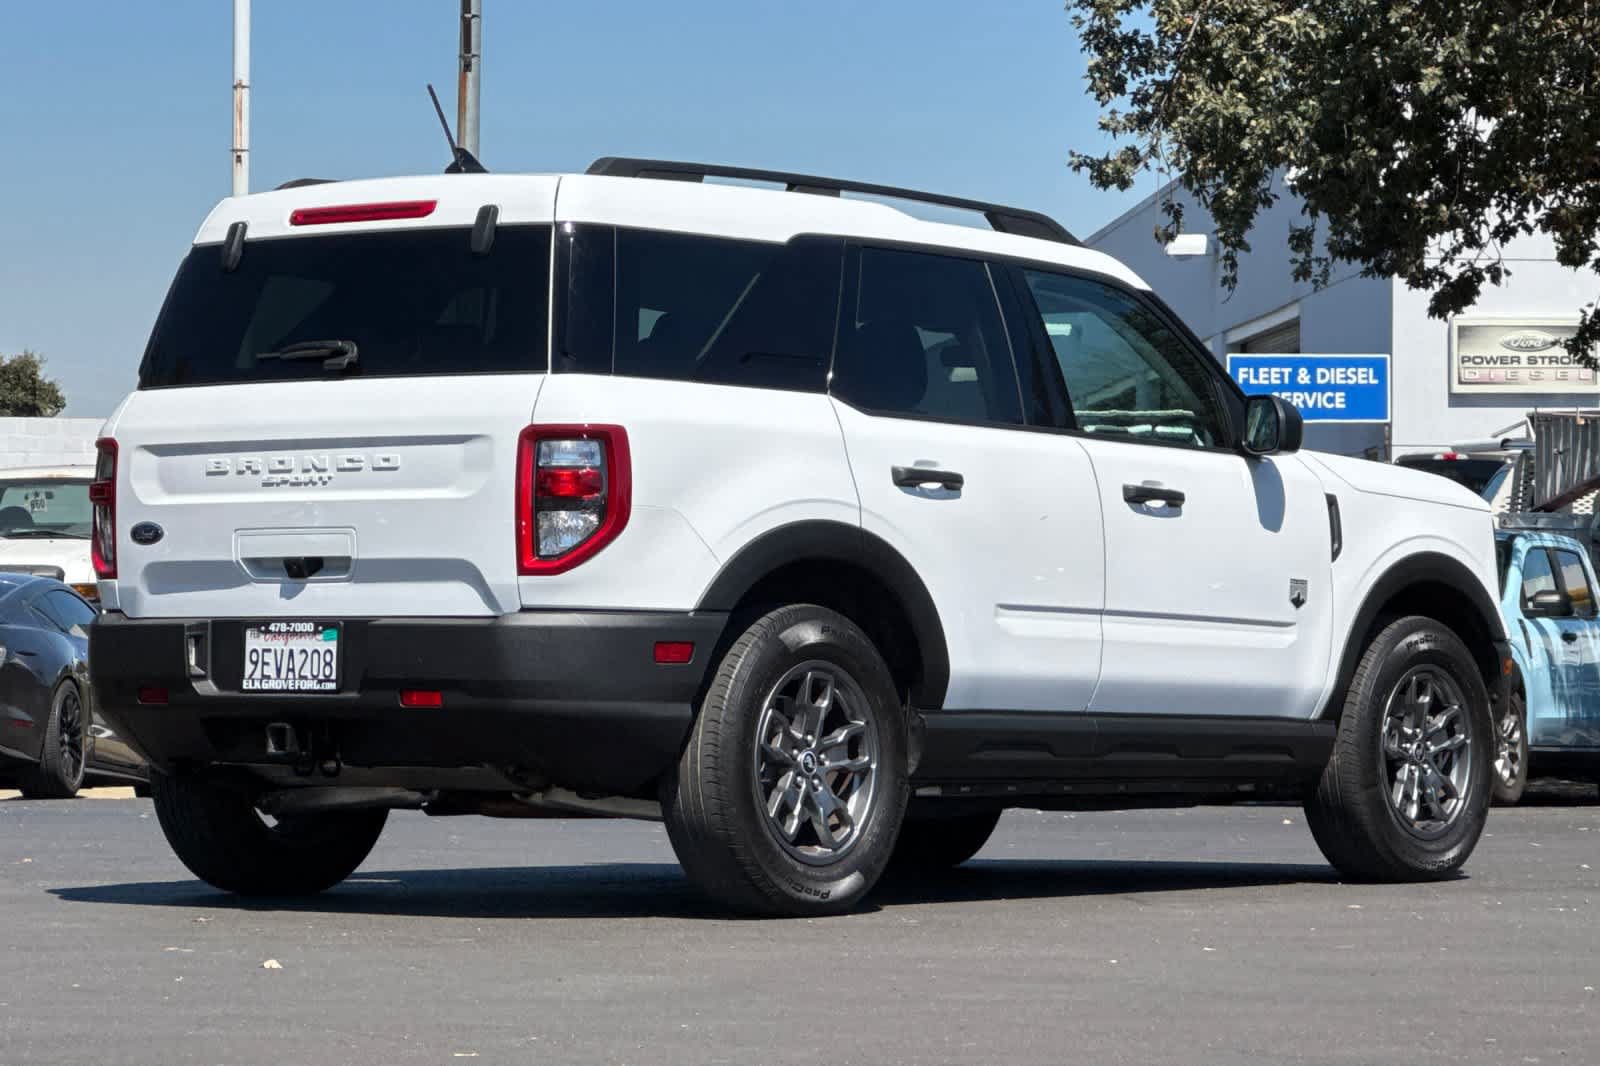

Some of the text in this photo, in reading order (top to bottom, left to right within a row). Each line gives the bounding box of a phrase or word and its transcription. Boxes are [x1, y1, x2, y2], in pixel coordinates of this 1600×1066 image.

[1460, 355, 1521, 366] POWER
[1237, 367, 1380, 385] FLEET & DIESEL
[1462, 369, 1594, 382] DIESEL
[205, 453, 402, 477] BRONCO
[261, 472, 335, 488] SPORT
[268, 622, 315, 633] 478-7000
[248, 647, 334, 680] 9EVA208
